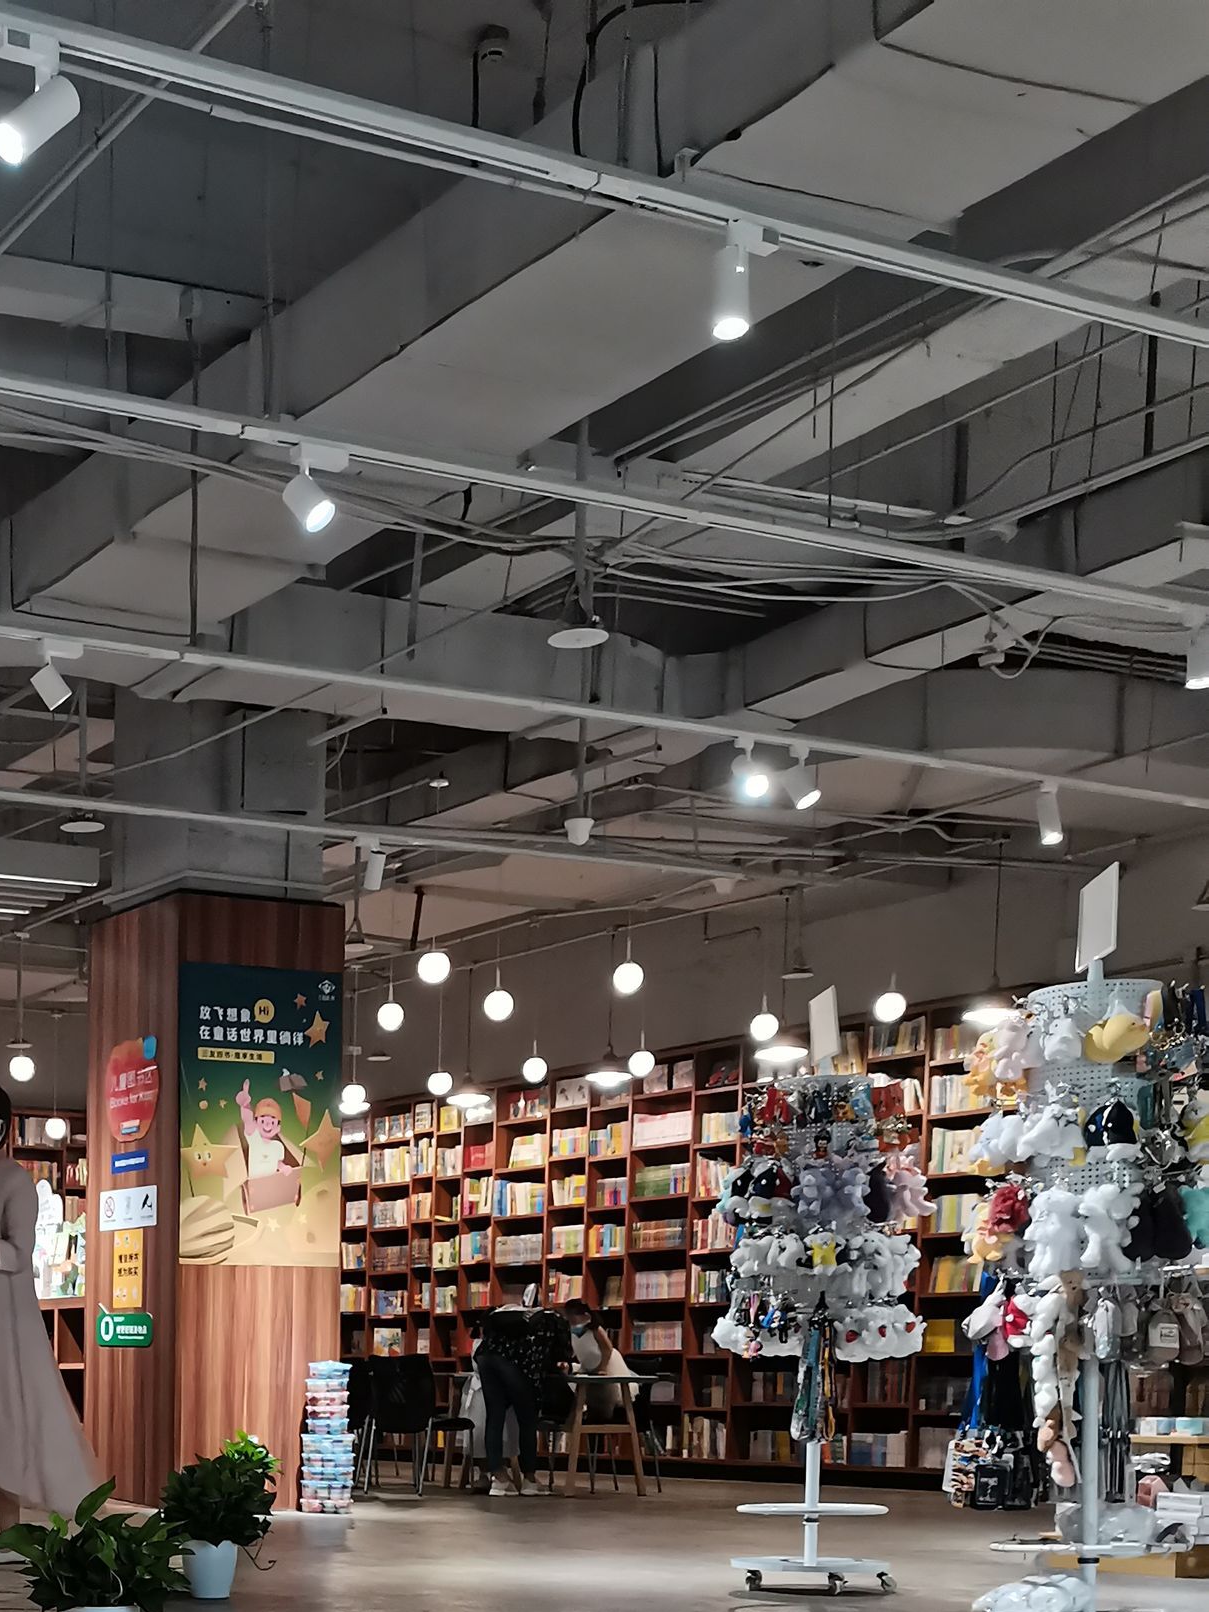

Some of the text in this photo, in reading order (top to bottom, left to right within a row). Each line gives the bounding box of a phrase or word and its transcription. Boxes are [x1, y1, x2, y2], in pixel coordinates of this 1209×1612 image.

[199, 1005, 251, 1023] 放飞想象
[258, 1006, 270, 1016] Hi
